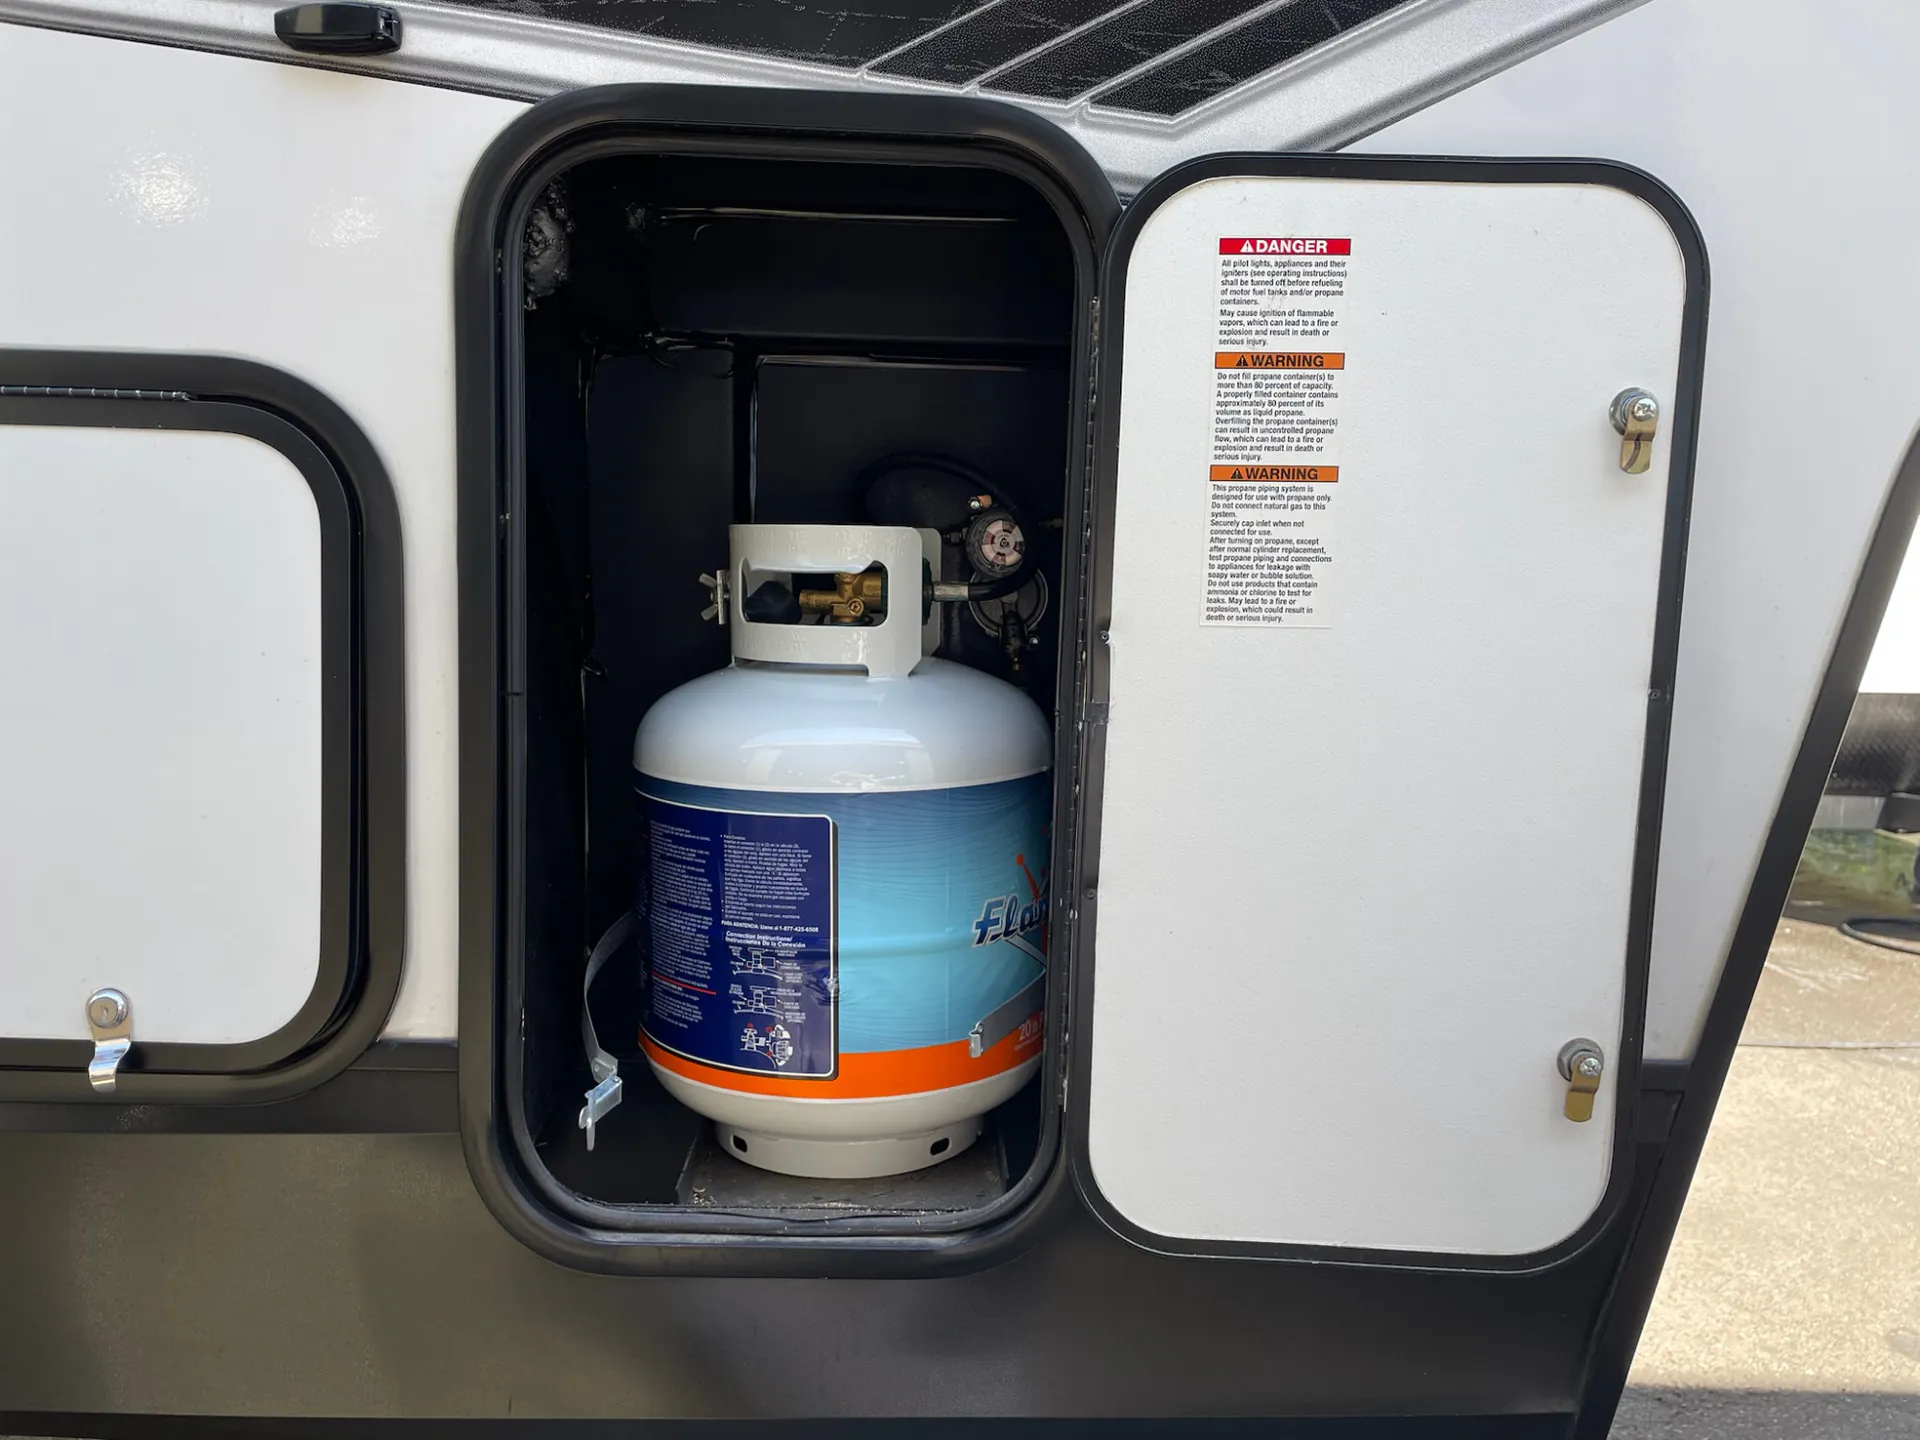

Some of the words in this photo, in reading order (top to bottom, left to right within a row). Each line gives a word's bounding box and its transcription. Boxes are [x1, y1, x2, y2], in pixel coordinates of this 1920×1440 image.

[1256, 240, 1328, 253] DANGER
[1233, 260, 1249, 268] pilot
[1251, 260, 1272, 268] lights,
[1274, 260, 1313, 269] appliances
[1329, 260, 1346, 268] their
[1221, 269, 1249, 278] igniters
[1250, 270, 1265, 278] (see
[1266, 270, 1301, 278] operating
[1302, 270, 1347, 278] instructions)
[1311, 280, 1343, 288] refueling
[1289, 289, 1313, 297] and/or
[1220, 309, 1235, 318] May
[1259, 309, 1287, 318] ignition
[1219, 329, 1253, 337] explosion
[1246, 338, 1268, 347] injury.
[1250, 355, 1324, 367] WARNING
[1217, 372, 1227, 380] Do
[1283, 373, 1326, 382] container(s)
[1327, 373, 1335, 381] to
[1265, 382, 1292, 390] percent
[1302, 382, 1333, 391] capacity.
[1223, 391, 1253, 399] properly
[1216, 400, 1266, 408] approximately
[1278, 400, 1305, 408] percent
[1253, 409, 1273, 417] liquid
[1215, 418, 1251, 426] Overfilling
[1296, 418, 1338, 427] container(s)
[1251, 426, 1258, 434] in
[1214, 444, 1248, 453] explosion
[1249, 444, 1263, 452] and
[1241, 453, 1263, 462] injury.
[1245, 467, 1318, 480] WARNING
[1258, 485, 1280, 493] piping
[1281, 485, 1306, 493] system
[1212, 493, 1243, 502] designed
[1316, 494, 1333, 503] only.
[1211, 511, 1238, 519] system.
[1210, 519, 1240, 528] Securely
[1245, 580, 1276, 589] products
[1228, 597, 1243, 606] May
[1260, 597, 1268, 605] to
[1206, 605, 1240, 614] explosion,
[1262, 614, 1284, 623] injury.
[726, 931, 756, 939] Connection
[757, 934, 793, 942] Instructions/
[725, 936, 761, 946] Instrucciones
[777, 940, 806, 948] Conexión
